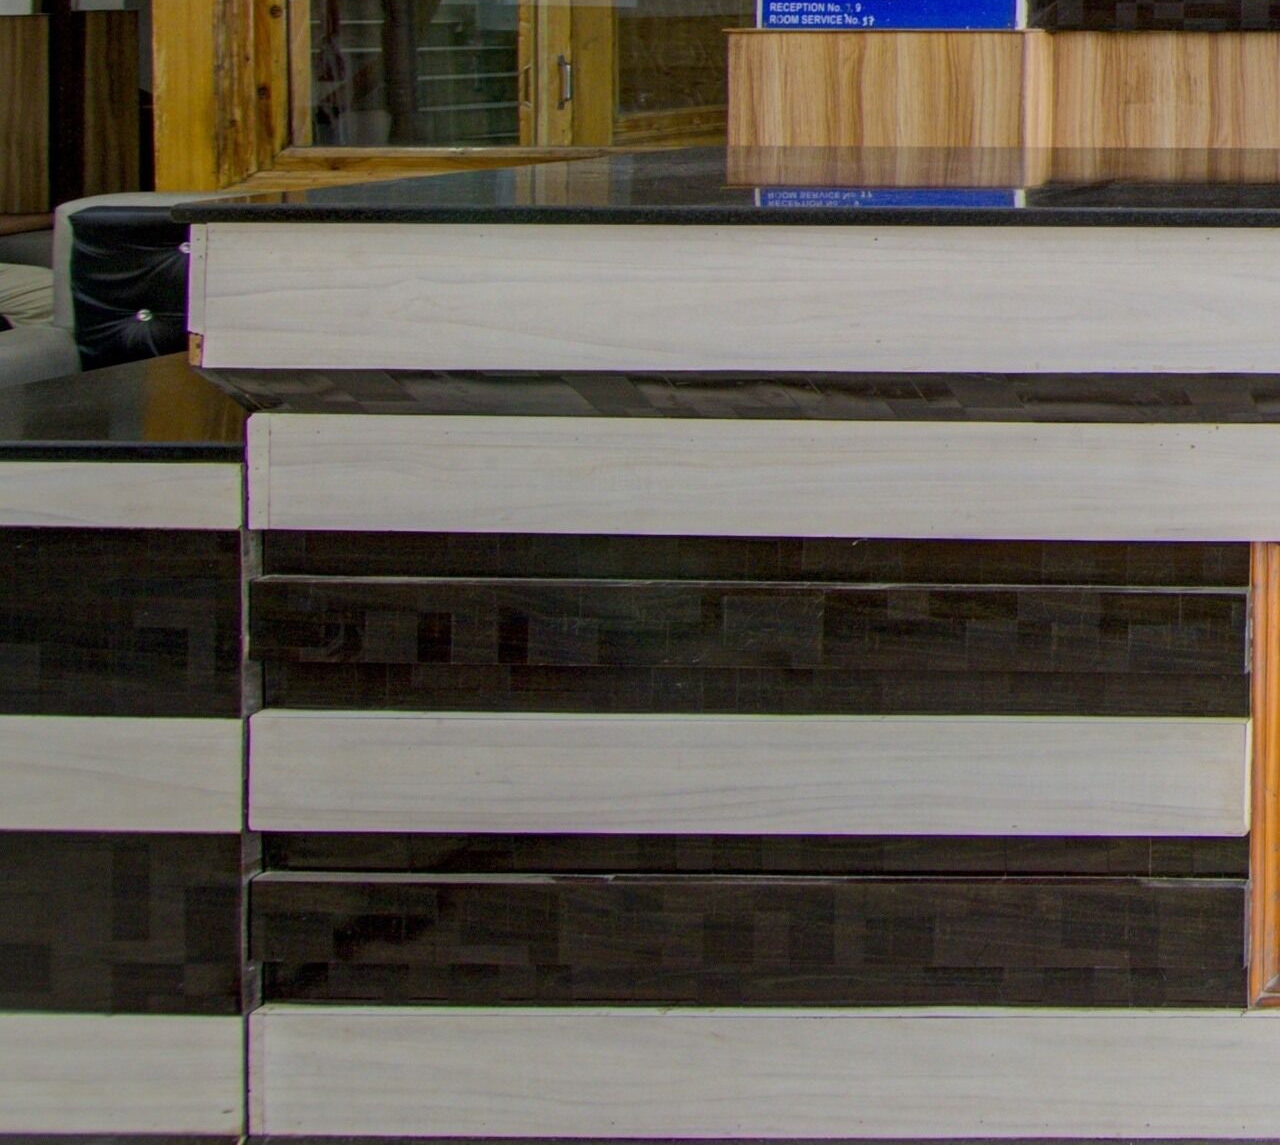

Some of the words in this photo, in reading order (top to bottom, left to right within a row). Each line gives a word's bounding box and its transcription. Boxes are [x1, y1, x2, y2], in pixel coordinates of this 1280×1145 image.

[769, 2, 825, 12] RECEPTION
[827, 3, 843, 12] No.
[769, 15, 799, 24] ROOM
[801, 15, 842, 24] SERVICE
